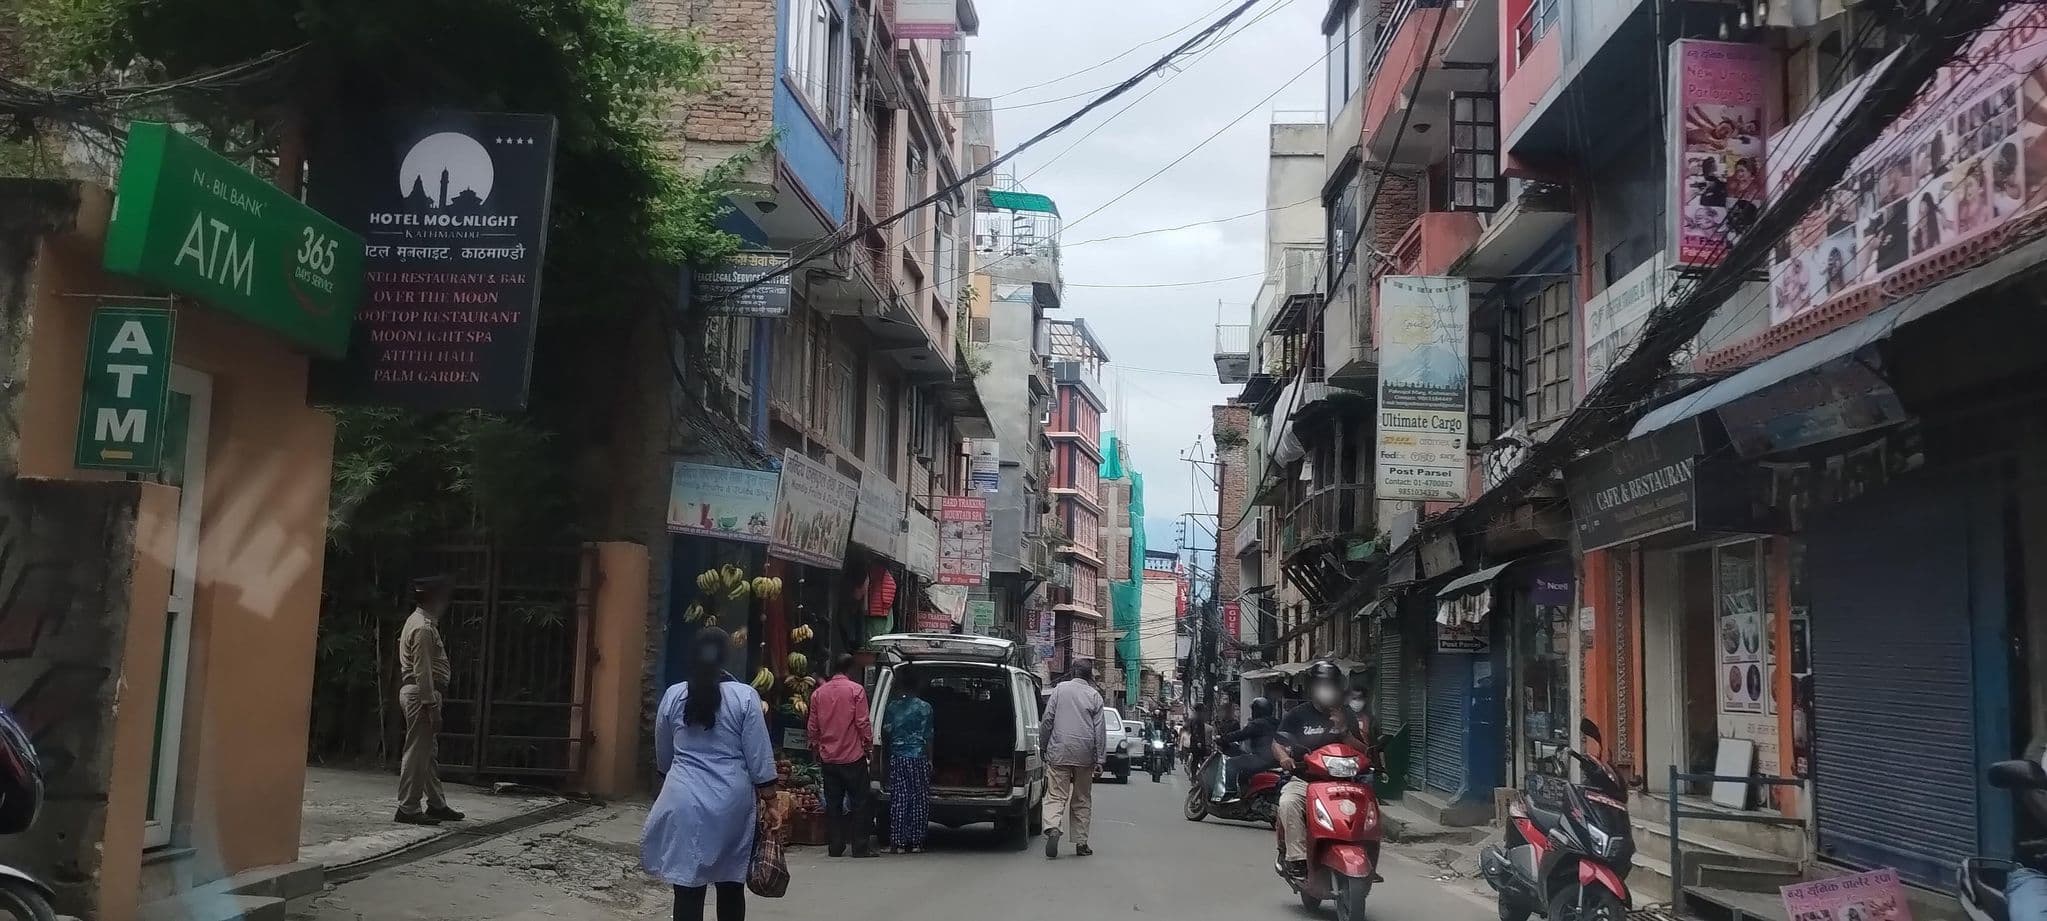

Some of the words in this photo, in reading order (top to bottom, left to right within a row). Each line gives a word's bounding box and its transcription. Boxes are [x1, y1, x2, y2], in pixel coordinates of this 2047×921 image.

[230, 188, 262, 218] BANK
[370, 213, 419, 226] HOTEL
[424, 215, 519, 227] MOONLIGHT
[174, 210, 256, 297] ATM
[297, 226, 339, 276] 365
[365, 244, 391, 258] टल
[294, 266, 312, 283] DAYS
[311, 271, 334, 294] SERVICE
[401, 272, 484, 285] RESTAURANT
[487, 274, 497, 284] &
[501, 273, 527, 284] BAR
[373, 290, 414, 304] OVER
[420, 291, 448, 304] THE
[453, 291, 499, 305] MOON
[423, 311, 521, 324] RESTAURANT
[371, 329, 465, 343] MOONLIGHT
[466, 330, 493, 343] SPA
[94, 320, 154, 444] ATM
[374, 369, 414, 382] PALM
[418, 370, 480, 383] GARDEN
[1382, 413, 1428, 429] Ultimate
[1431, 415, 1463, 433] Cargo
[1389, 467, 1414, 476] Post
[1417, 468, 1452, 477] Parsel
[1596, 487, 1621, 512] CAFE
[1620, 483, 1631, 504] &
[1628, 456, 1695, 500] RESTAURANT
[1547, 581, 1569, 591] Ncell
